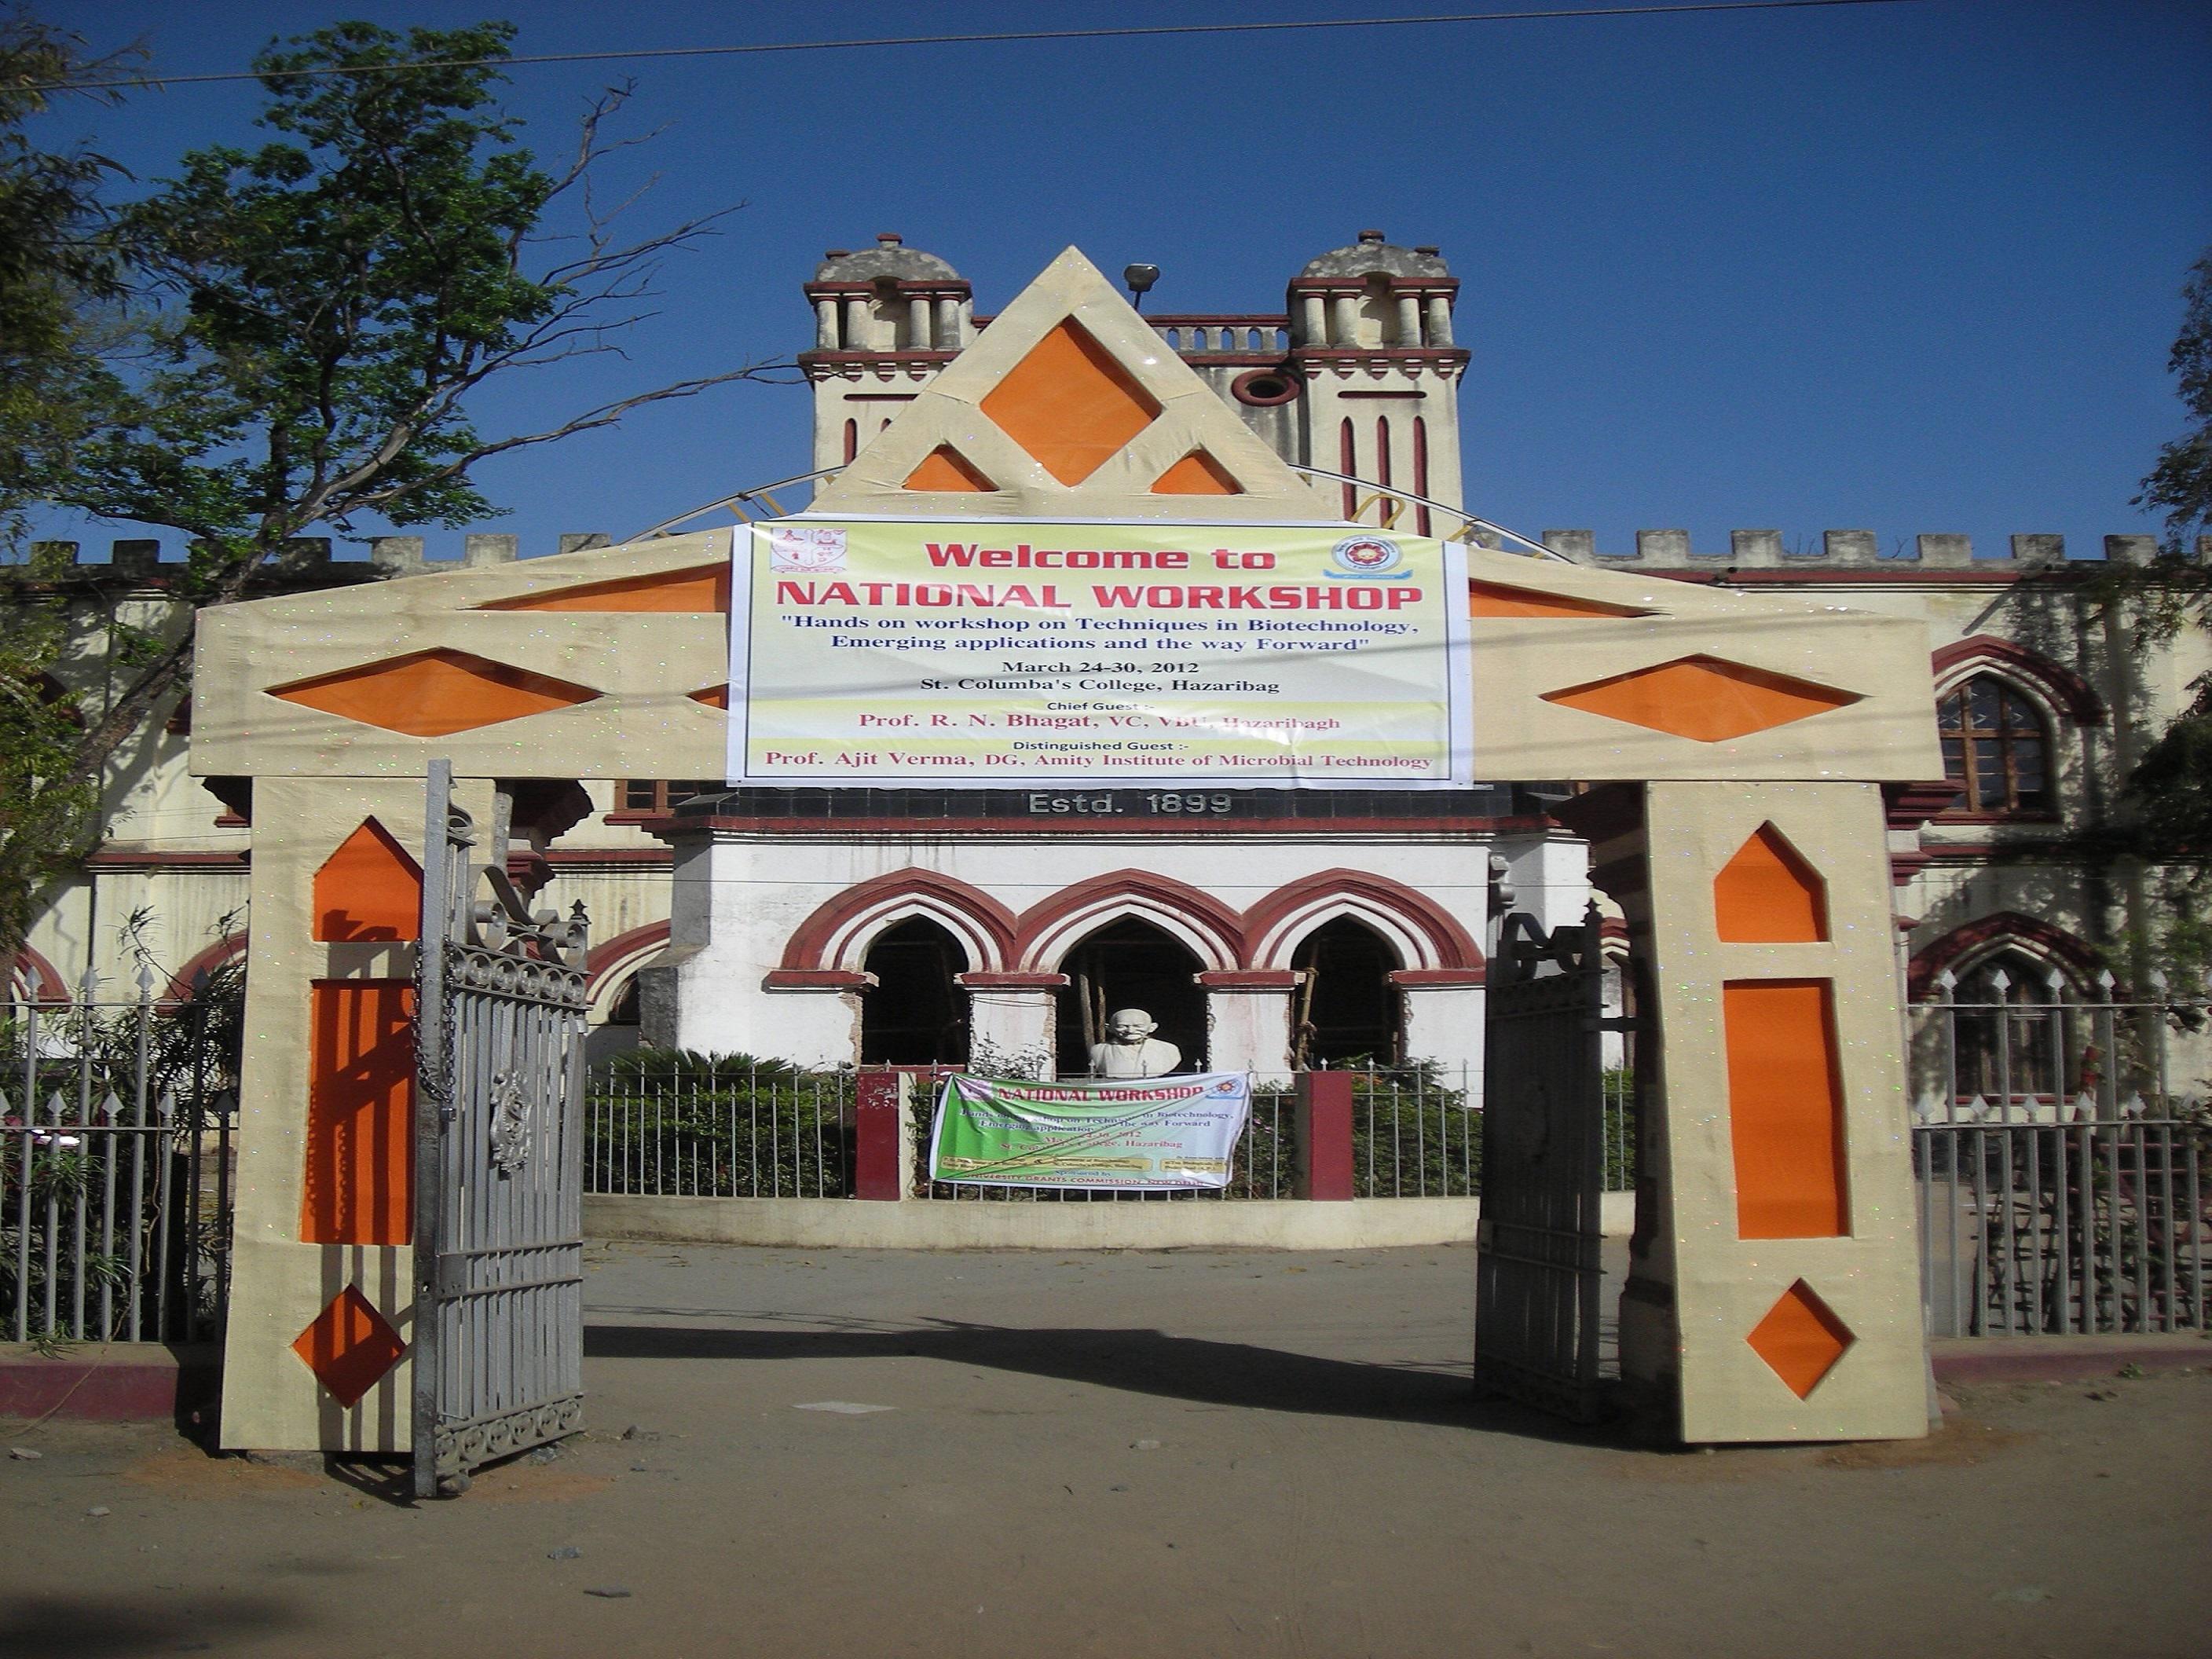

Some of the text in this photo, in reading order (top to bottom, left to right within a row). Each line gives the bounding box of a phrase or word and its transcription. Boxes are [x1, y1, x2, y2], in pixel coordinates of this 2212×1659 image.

[925, 544, 1276, 569] Welcome to
[777, 581, 1423, 610] NATIONAL WORKSHOP
[782, 615, 869, 628] "Hands
[877, 620, 906, 628] on
[915, 617, 1030, 632] workshop
[1075, 618, 1208, 633] Techniques
[1217, 619, 1238, 631] in
[1248, 619, 1418, 635] Biotechnology,
[832, 635, 1369, 653] Emerging applications and the way Forward"
[1002, 661, 1199, 673] March 24-30, 2012
[921, 678, 1280, 694] St. Columba's College, Hazaribag
[1047, 701, 1088, 711] Chief
[1092, 702, 1137, 711] Guest
[859, 714, 919, 727] Prof.
[932, 714, 958, 727] R.
[969, 714, 995, 727] N.
[1007, 714, 1099, 730] Bhagat,
[1108, 716, 1149, 727] VC,
[1223, 717, 1340, 731] Hazaribagh
[1013, 741, 1122, 752] Distinguished
[1126, 742, 1174, 750] Guest
[766, 752, 1433, 770] Prof. Ajit Verma, DG, Amity Institute of Microbial Technology
[1028, 793, 1231, 815] Estd. 1899
[998, 1086, 1203, 1101] NATIONAL WORKSHOP
[1157, 1111, 1234, 1120] Biotechnology,
[1125, 1140, 1183, 1148] Hazaribag
